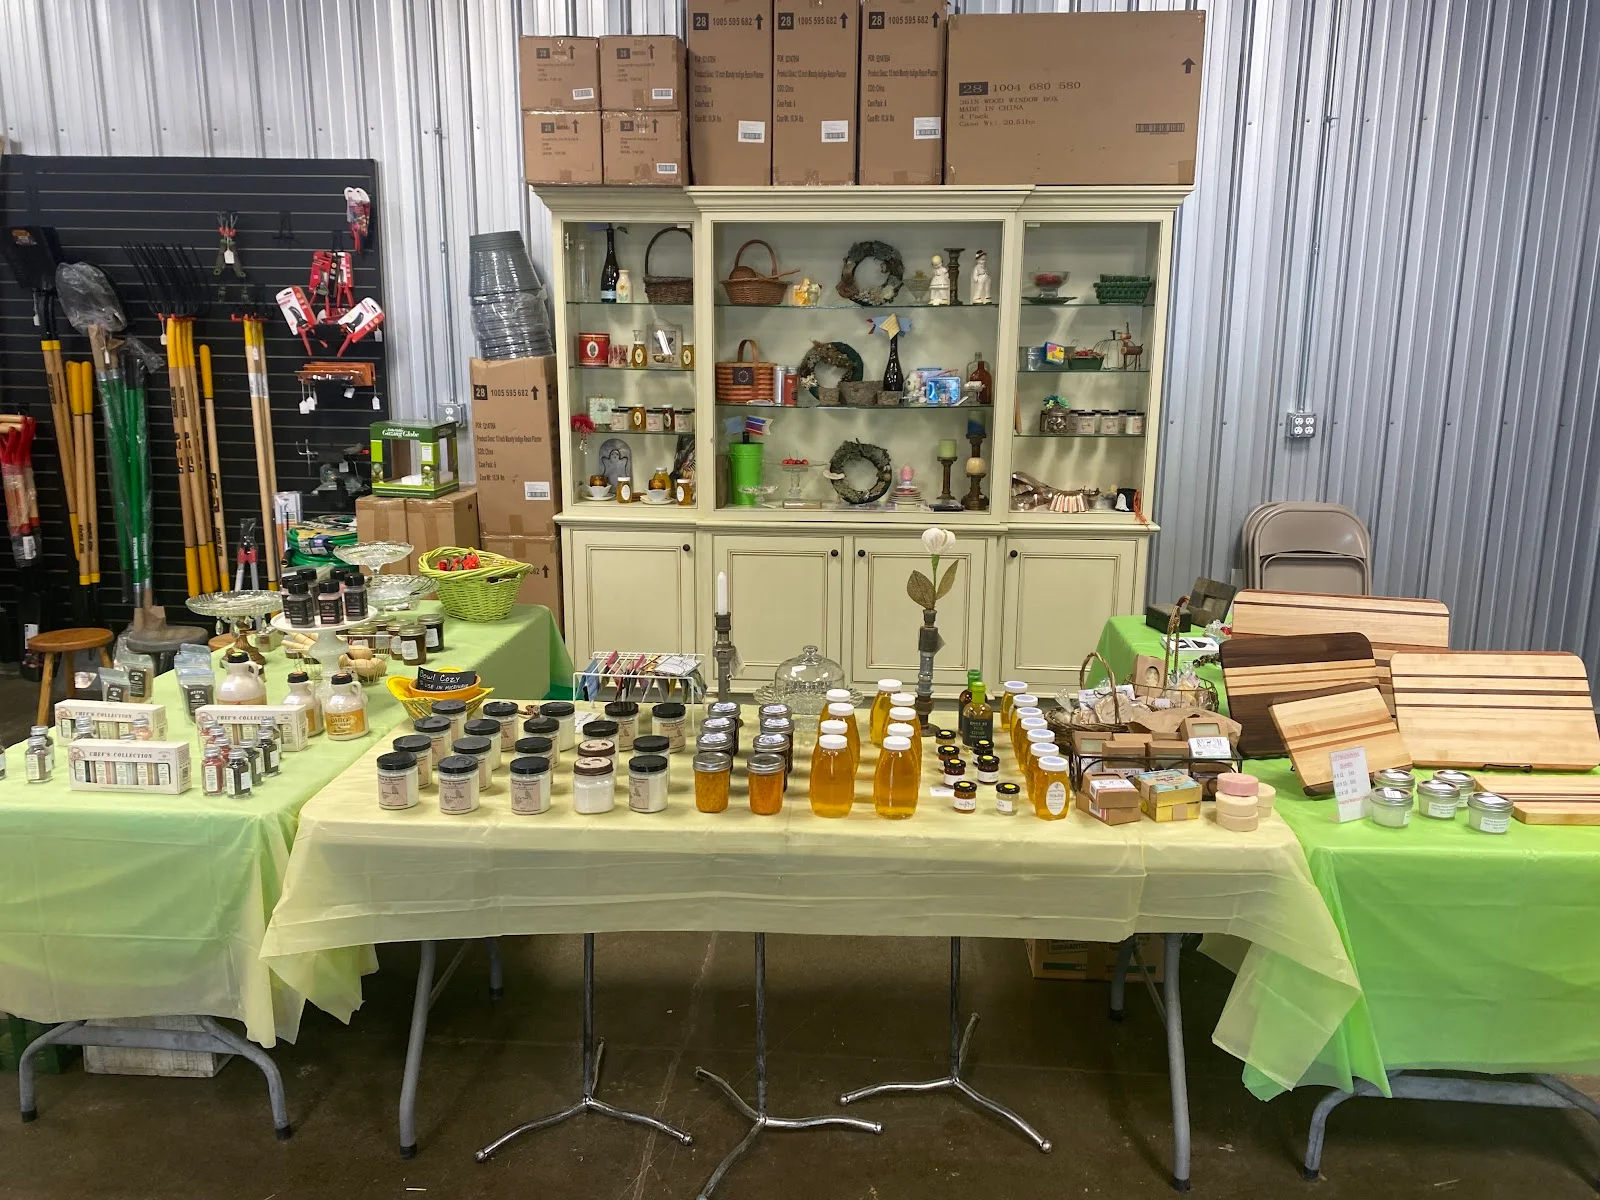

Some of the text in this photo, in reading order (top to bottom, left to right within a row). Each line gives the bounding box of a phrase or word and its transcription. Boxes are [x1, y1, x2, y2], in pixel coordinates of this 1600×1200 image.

[696, 17, 707, 27] 28
[713, 17, 753, 26] 1005 595 682
[781, 16, 791, 27] 28
[798, 16, 838, 25] 1005 595 682
[872, 15, 882, 26] 28
[889, 16, 929, 25] 1005 595 682
[963, 84, 983, 94] 28
[993, 81, 1081, 92] 1004 680 580
[476, 388, 485, 397] 28
[491, 389, 529, 397] 1005 595 682
[382, 429, 403, 438] Gazing
[403, 430, 420, 438] Globe
[440, 674, 461, 682] Cozy
